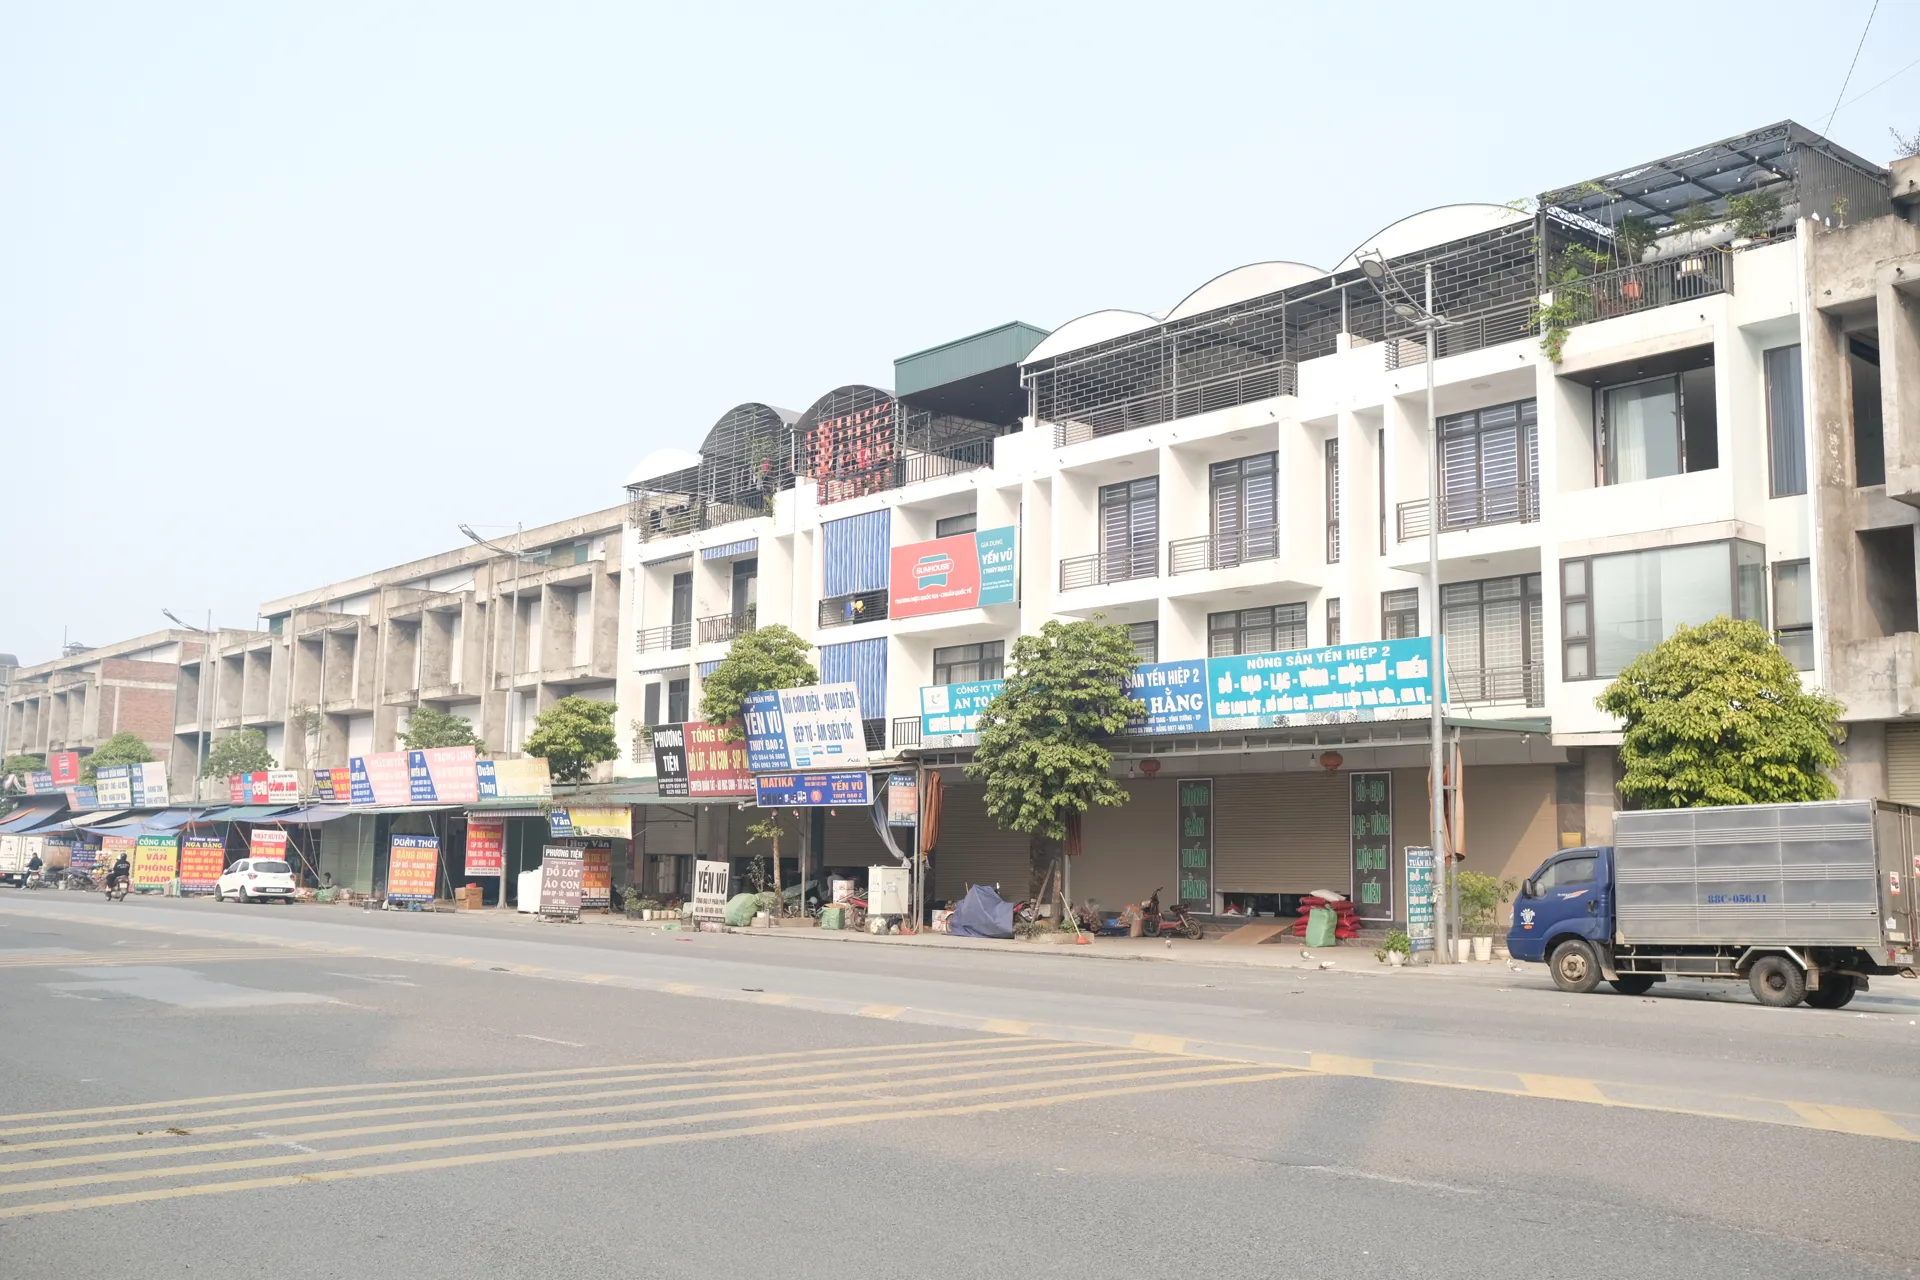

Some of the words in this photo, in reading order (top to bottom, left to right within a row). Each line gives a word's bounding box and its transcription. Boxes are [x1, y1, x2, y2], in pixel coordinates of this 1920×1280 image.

[982, 549, 1001, 565] YẾN
[1000, 548, 1013, 562] VŨ
[916, 564, 950, 575] SUNHOUSE
[1247, 657, 1282, 671] NÔNG
[1286, 652, 1313, 666] SẢN
[1317, 648, 1343, 664] YẾN
[1347, 645, 1378, 662] HIỆP
[1382, 646, 1391, 657] 2
[1125, 669, 1144, 689] SẢN
[1146, 667, 1165, 687] YẾN
[1167, 666, 1190, 688] HIỆP
[1192, 669, 1200, 683] 2
[956, 683, 979, 695] CÔNG
[981, 685, 990, 693] TY
[824, 692, 840, 714] QUẠT
[840, 687, 856, 713] ĐIỆN
[954, 698, 970, 710] AN
[1150, 687, 1203, 714] HẰNG
[744, 704, 766, 735] YẾN
[766, 705, 782, 734] VŨ
[654, 729, 683, 748] PHƯƠNG
[691, 725, 715, 744] TỔNG
[793, 720, 805, 743] BẾP
[827, 720, 841, 741] SIÊU
[841, 716, 854, 740] TỐC
[765, 739, 779, 753] ĐẠO
[779, 738, 785, 749] 2
[663, 751, 679, 775] TIỆN
[761, 777, 794, 788] MATIKA
[832, 780, 849, 791] YẾN
[852, 780, 864, 791] VŨ
[1181, 783, 1208, 806] NÔNG
[552, 817, 570, 825] Vân
[1184, 812, 1204, 836] SẢN
[139, 837, 159, 846] CÔNG
[418, 838, 438, 848] THÚY
[546, 848, 569, 858] PHƯƠNG
[570, 848, 583, 860] TIỆN
[1181, 842, 1206, 868] TUẤN
[1356, 844, 1372, 874] MỘC
[546, 865, 560, 876] ĐỒ
[562, 867, 580, 878] LÓT
[699, 864, 715, 894] YẾN
[716, 868, 727, 895] VŨ
[544, 878, 559, 888] ÁO
[560, 880, 580, 889] CON
[1181, 872, 1207, 899] HẰNG
[1362, 876, 1380, 904] MIẾN
